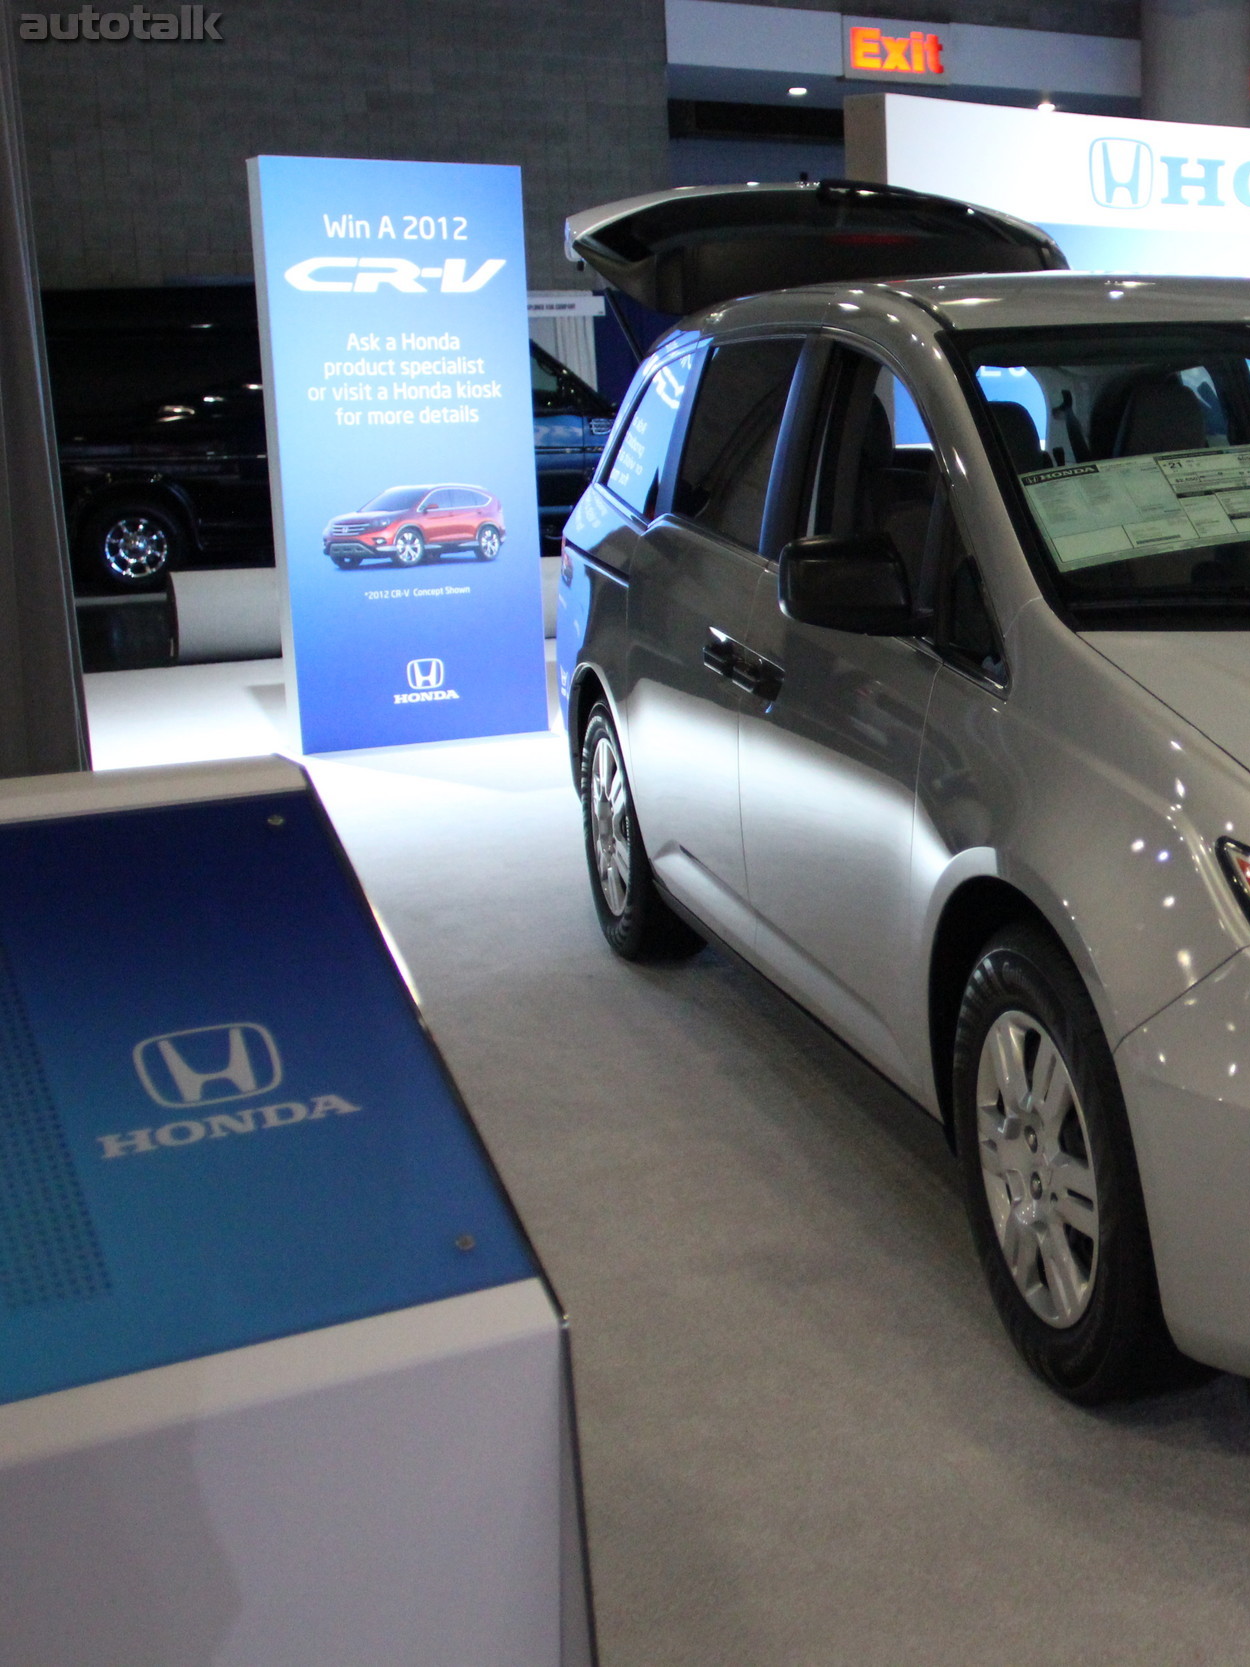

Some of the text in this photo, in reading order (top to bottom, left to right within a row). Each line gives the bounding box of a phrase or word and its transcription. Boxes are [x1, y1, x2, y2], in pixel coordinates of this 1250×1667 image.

[849, 26, 944, 74] Exit
[322, 213, 468, 241] Win A 2012
[283, 256, 507, 293] CR-V
[346, 332, 461, 352] Ask a Honda
[323, 356, 486, 380] product specialist
[307, 380, 502, 401] or visit a Honda kiosk
[335, 405, 480, 425] for more details
[1039, 467, 1095, 481] HONDA
[390, 588, 410, 599] CR-V
[413, 586, 444, 597] Concept
[444, 585, 471, 595] Shown
[393, 689, 460, 704] HONDA
[97, 1094, 362, 1159] HONDA
